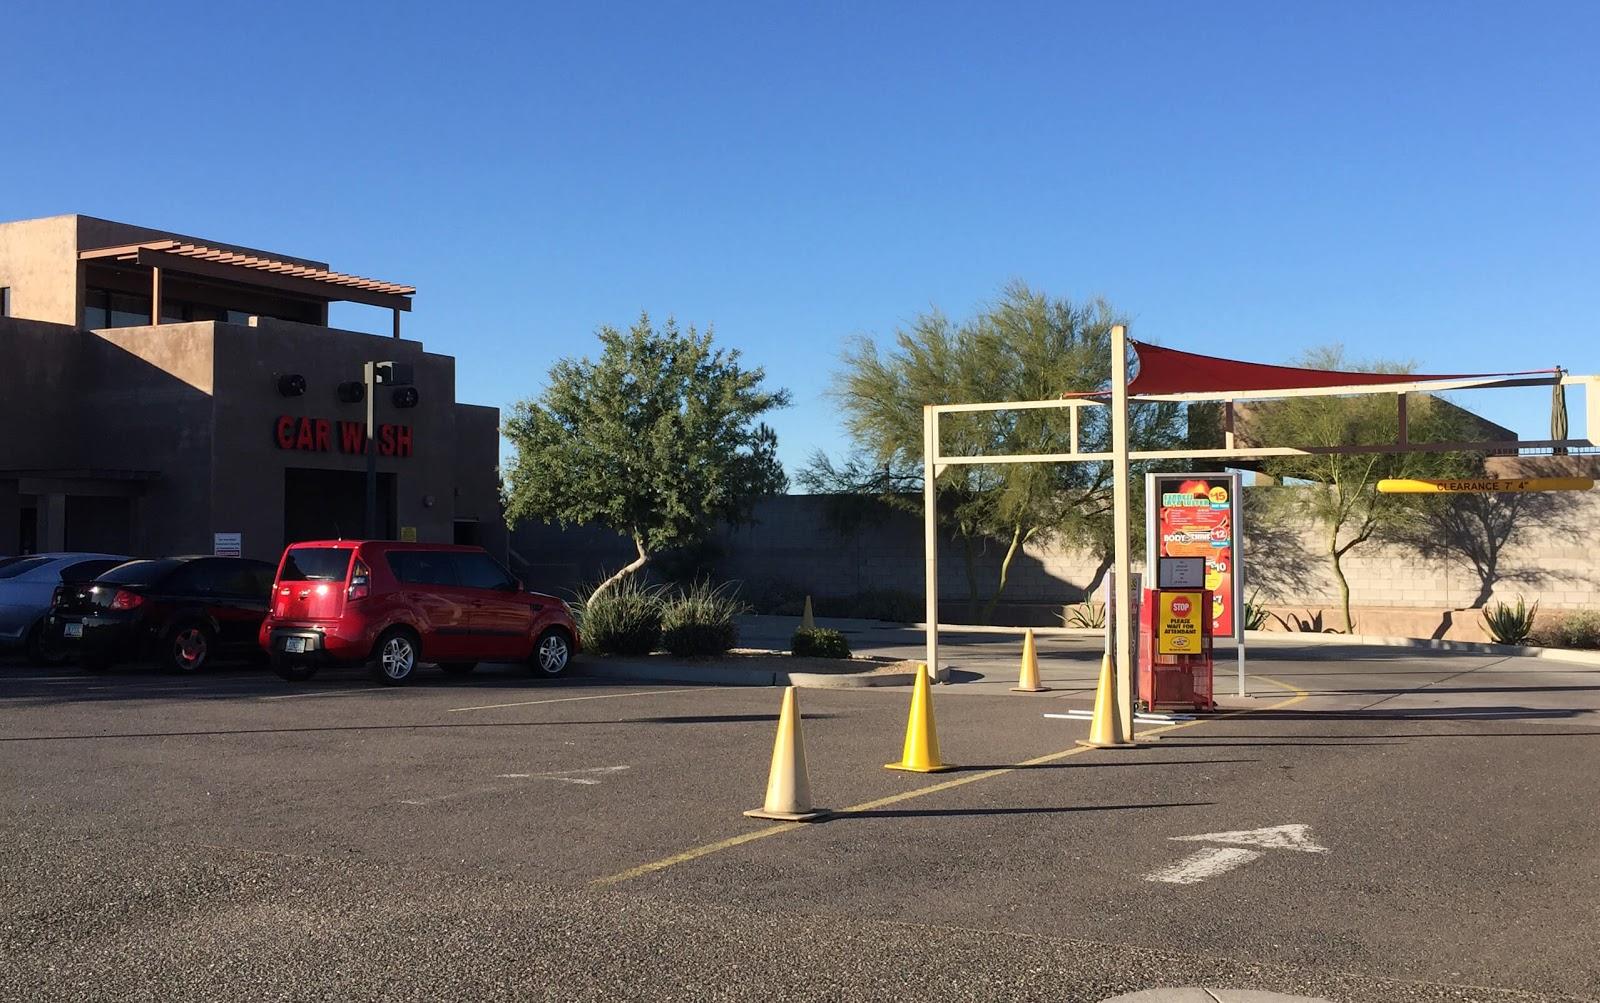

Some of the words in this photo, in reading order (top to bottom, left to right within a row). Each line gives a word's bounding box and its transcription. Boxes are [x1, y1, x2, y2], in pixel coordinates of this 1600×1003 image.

[275, 415, 332, 450] CAR
[1437, 482, 1499, 491] CLEARANCE
[1173, 603, 1189, 611] STOP
